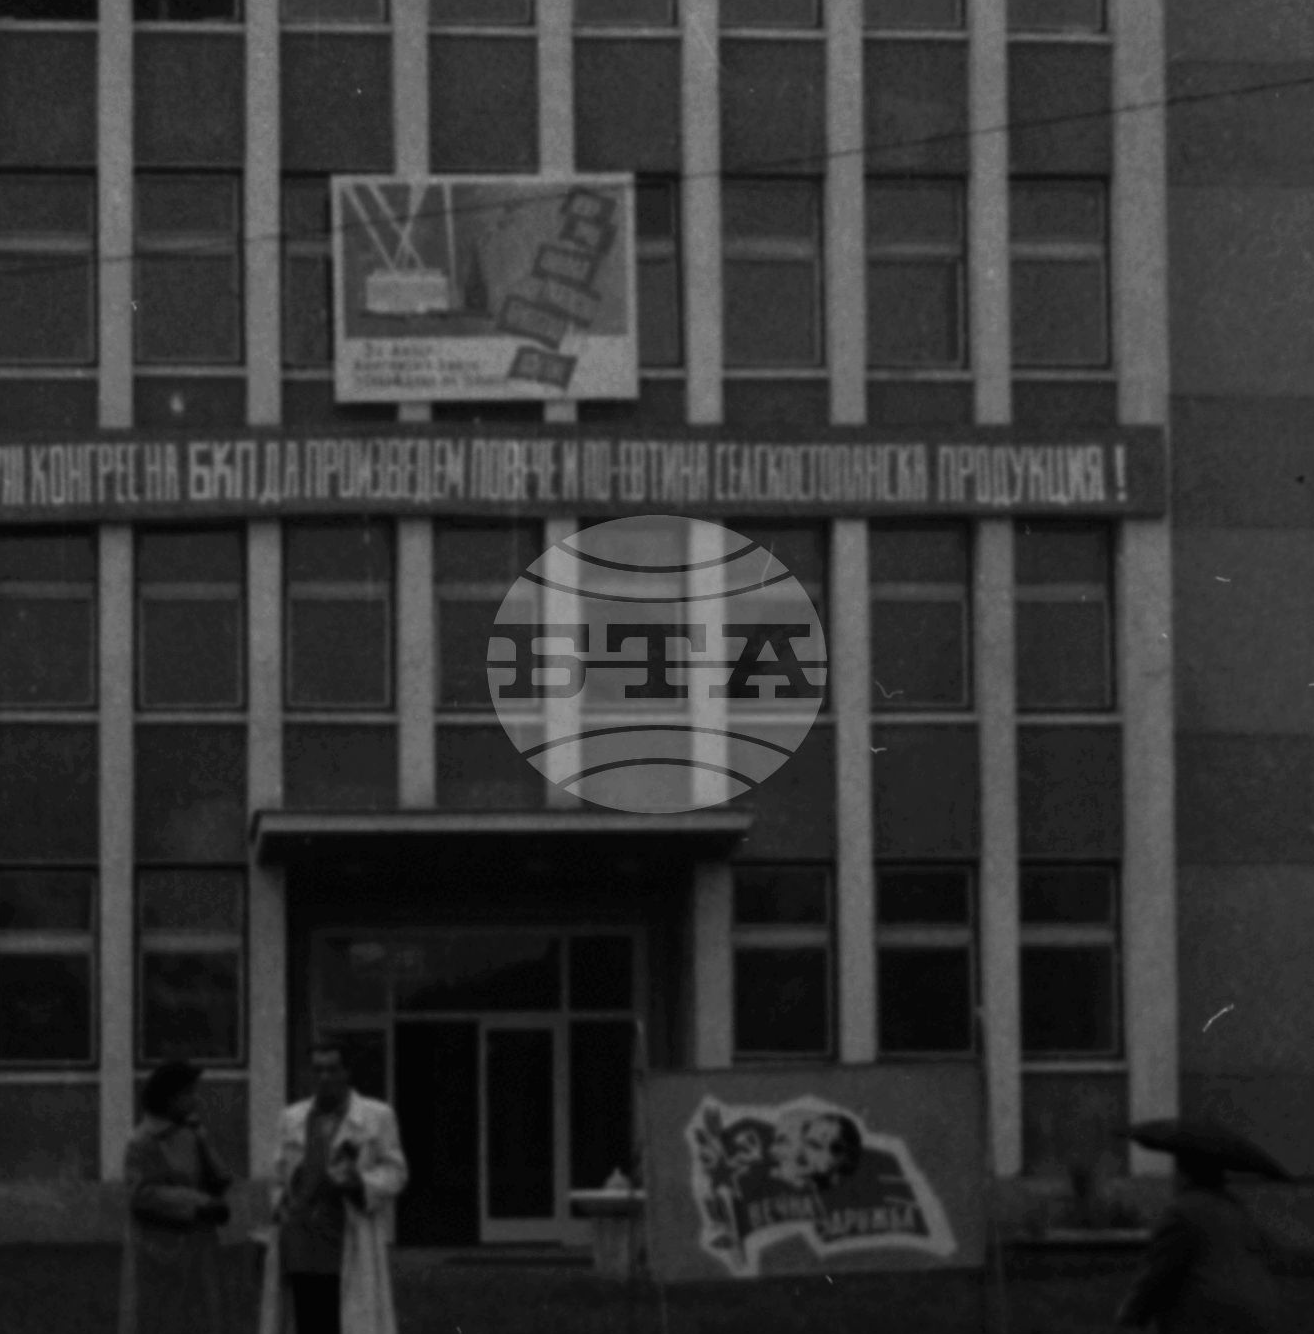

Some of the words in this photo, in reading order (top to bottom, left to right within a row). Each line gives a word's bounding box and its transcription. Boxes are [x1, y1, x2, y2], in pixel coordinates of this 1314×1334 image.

[29, 441, 140, 505] КОНГРЕС
[143, 441, 181, 504] НА
[187, 439, 258, 501] БКП
[259, 439, 300, 505] ДА
[304, 438, 466, 504] ПРОИЗВЕДЕМ
